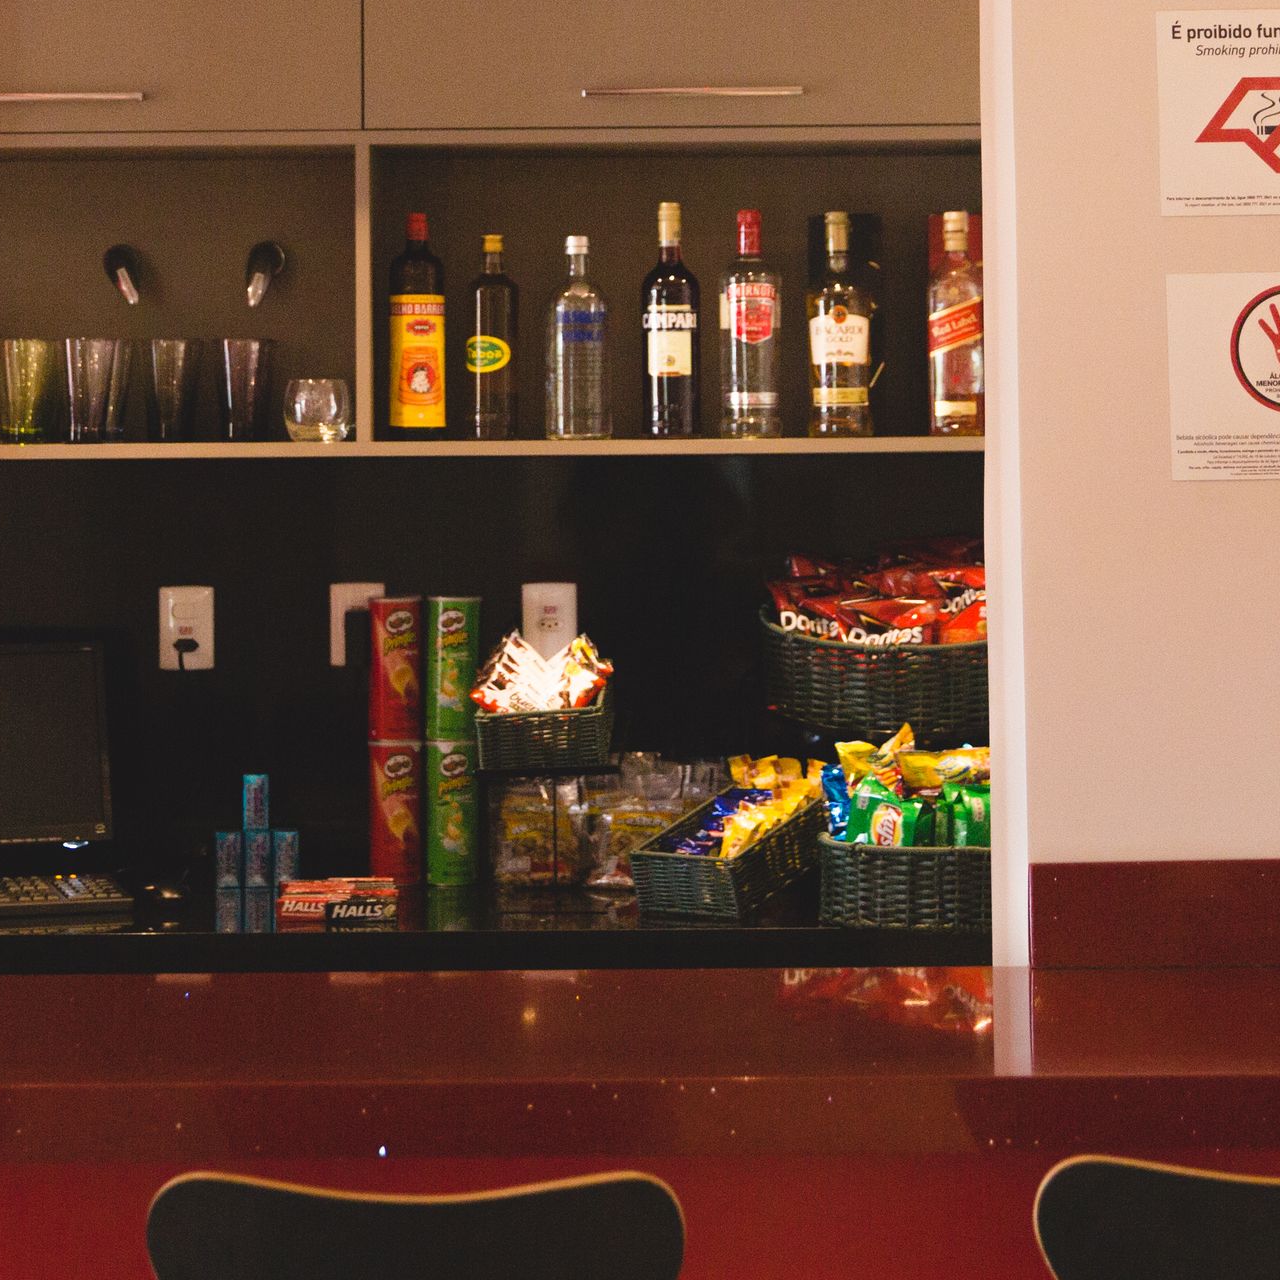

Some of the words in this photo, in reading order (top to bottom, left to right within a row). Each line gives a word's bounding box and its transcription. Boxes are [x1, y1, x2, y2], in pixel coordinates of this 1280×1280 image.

[1171, 20, 1182, 40] É
[1186, 23, 1252, 43] proibido
[1195, 44, 1246, 58] Smoking
[281, 899, 325, 913] HALLS
[331, 903, 383, 919] HALLS
